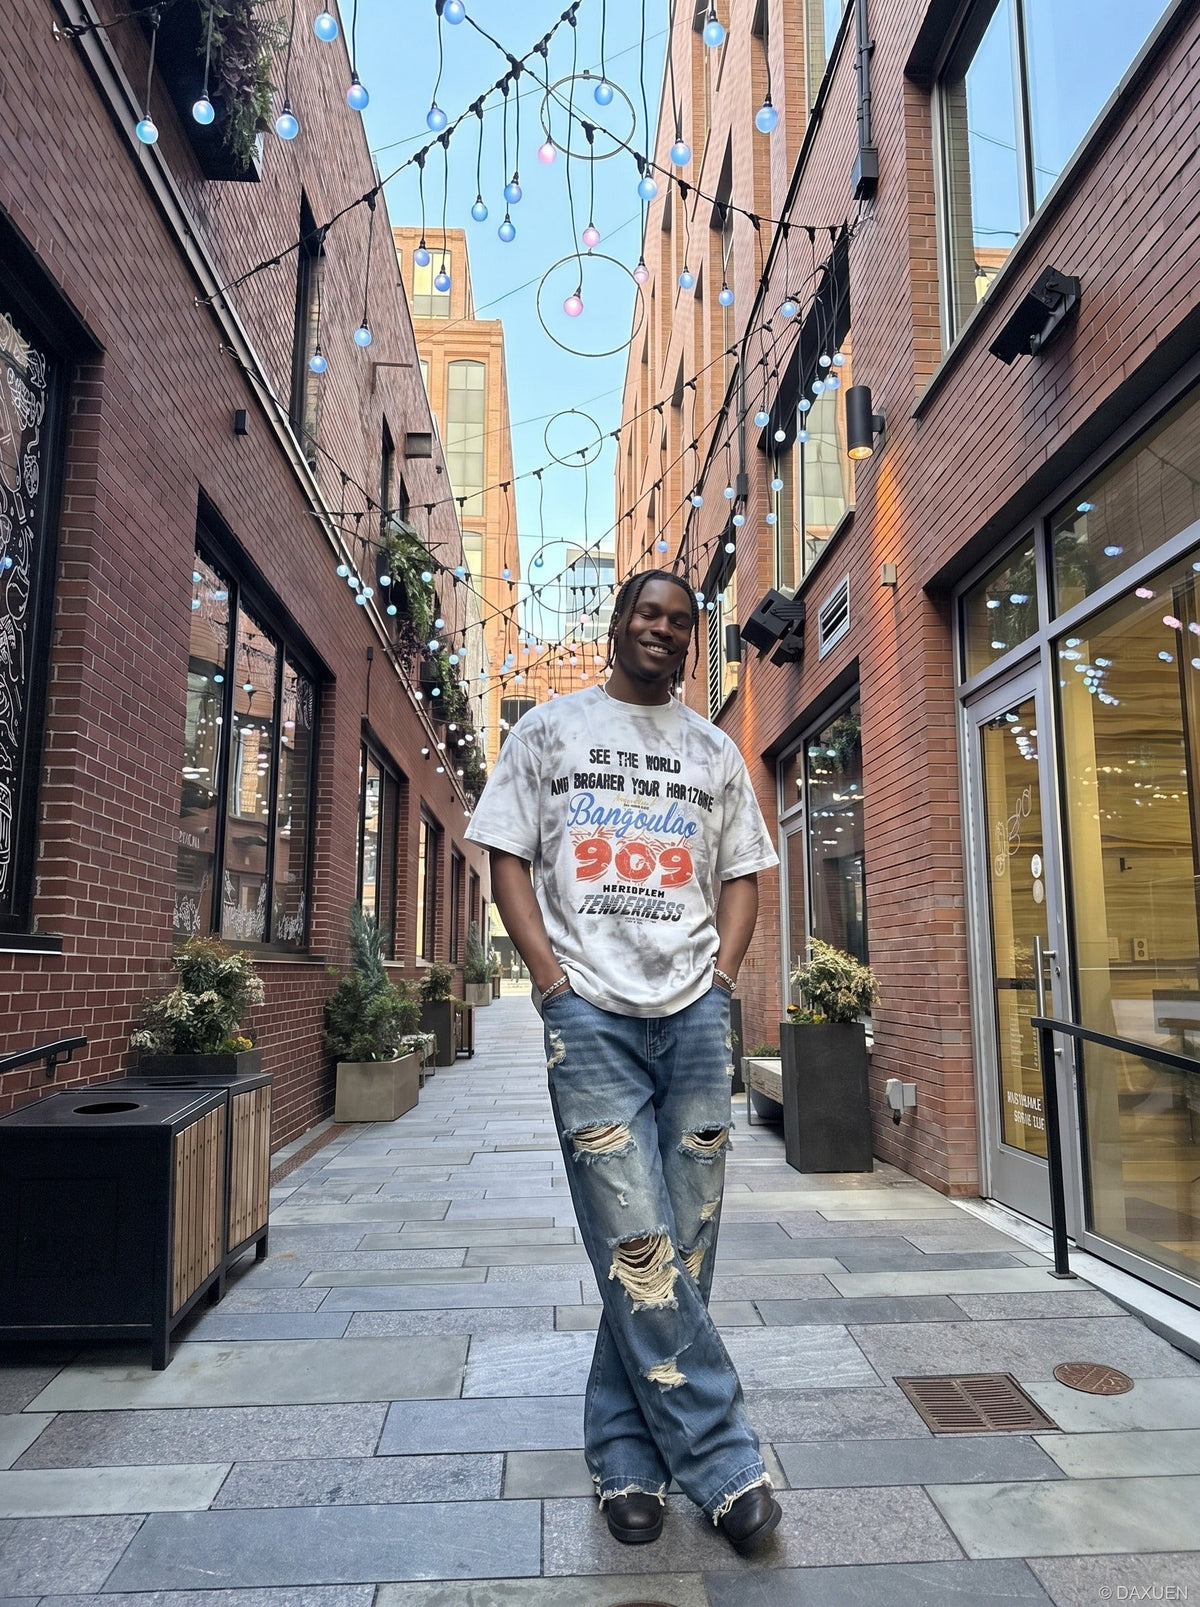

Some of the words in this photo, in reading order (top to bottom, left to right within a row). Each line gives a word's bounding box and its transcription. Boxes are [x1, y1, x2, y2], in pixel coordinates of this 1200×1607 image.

[589, 748, 611, 765] SEE
[616, 750, 639, 769] THE
[645, 754, 681, 774] WORLD
[551, 776, 569, 796] AND
[631, 777, 660, 797] YOUR
[574, 837, 694, 886] 909
[577, 894, 686, 922] TENDERNESS
